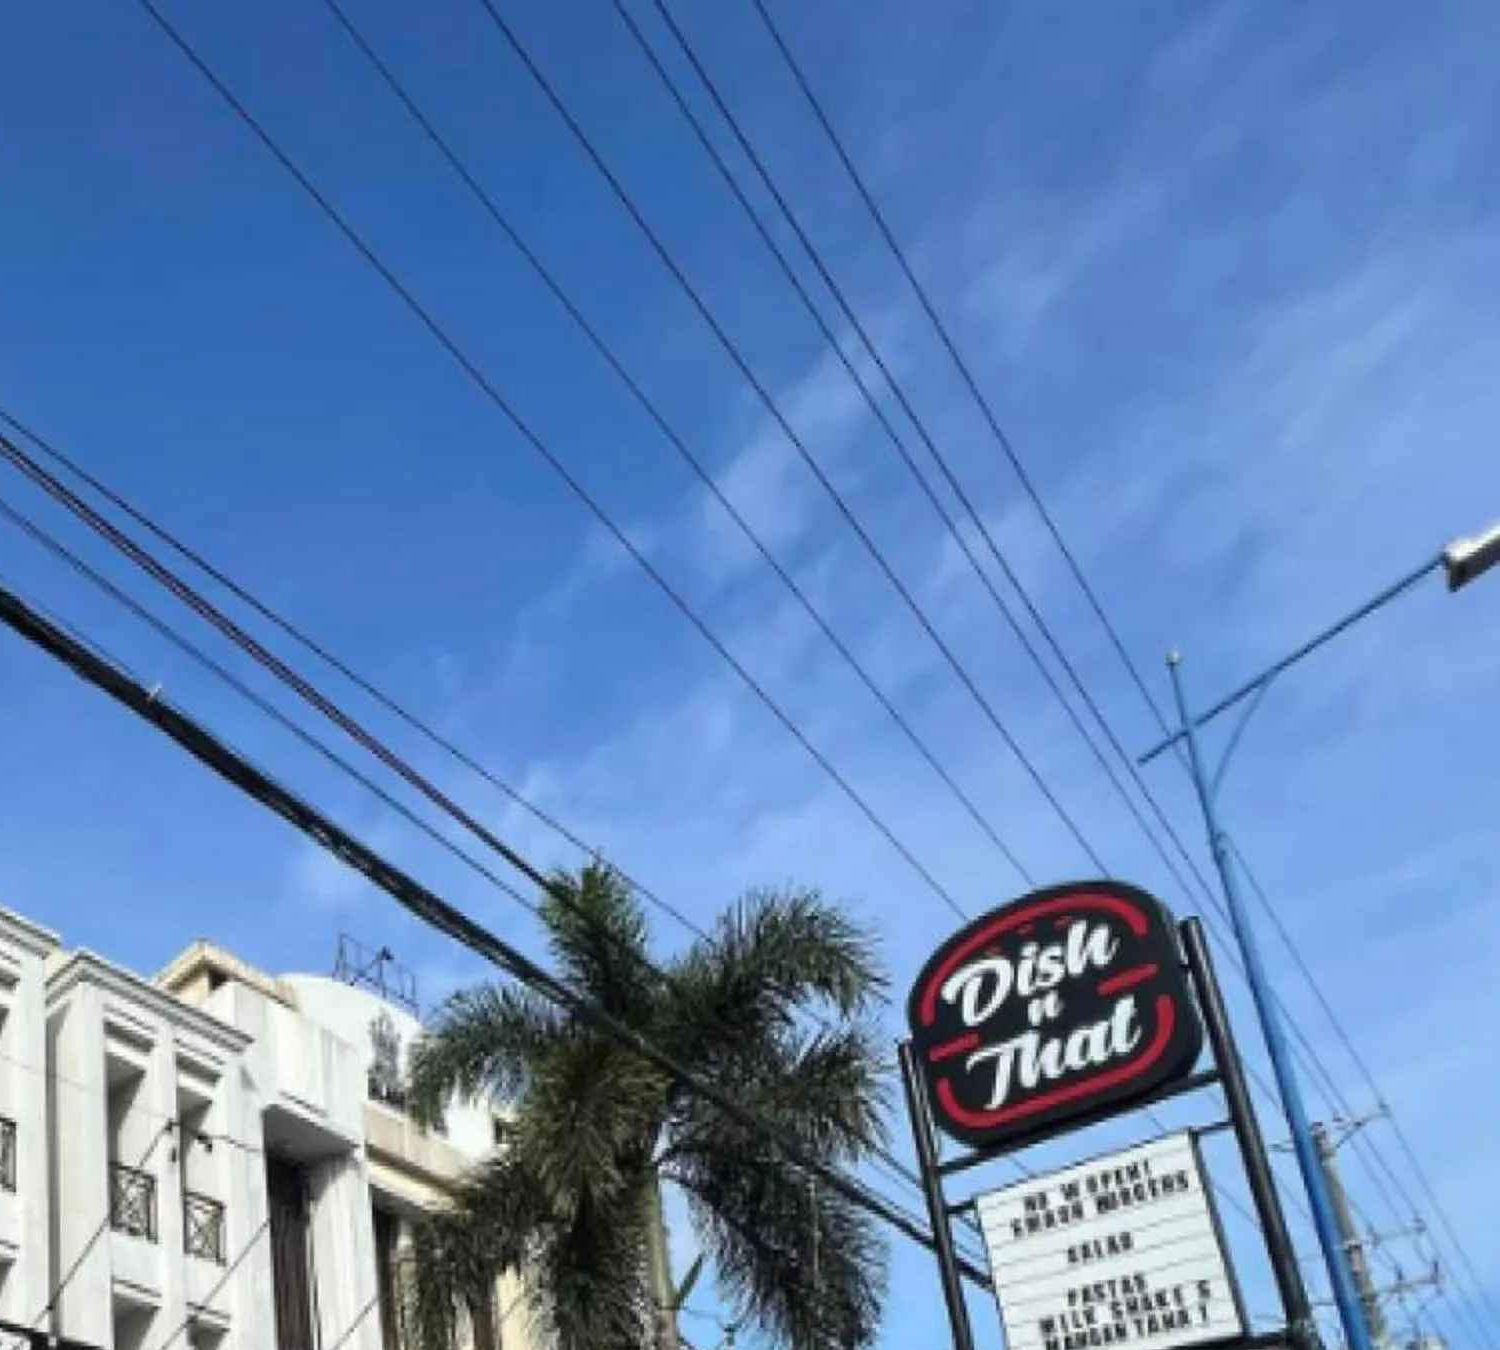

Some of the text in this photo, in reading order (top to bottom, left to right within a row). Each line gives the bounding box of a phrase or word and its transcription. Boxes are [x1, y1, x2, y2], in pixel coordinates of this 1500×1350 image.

[941, 919, 1121, 1027] Dish
[1028, 989, 1064, 1026] n
[965, 994, 1142, 1111] That
[1067, 1272, 1148, 1307] PASTAS
